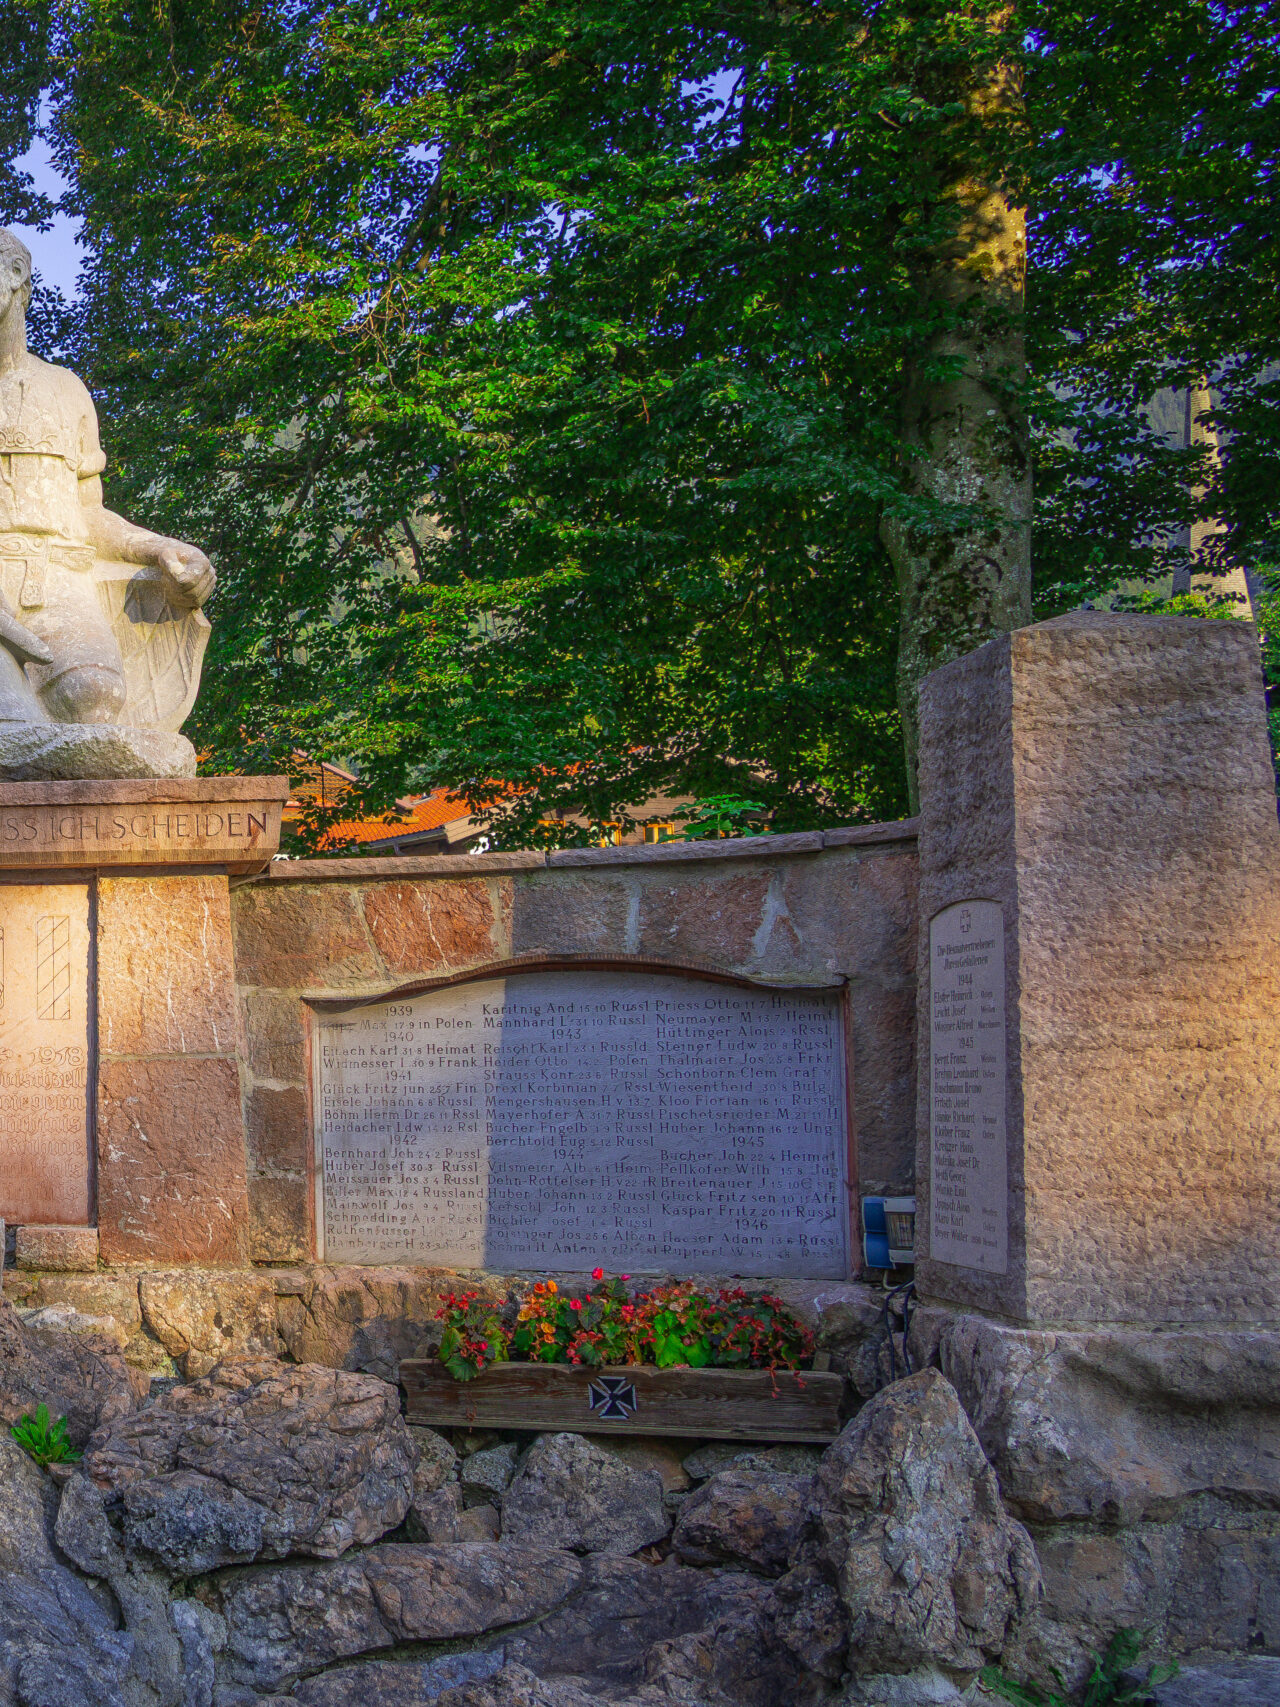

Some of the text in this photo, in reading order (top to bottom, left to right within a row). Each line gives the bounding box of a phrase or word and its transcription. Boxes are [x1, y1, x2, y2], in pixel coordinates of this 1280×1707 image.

[50, 817, 99, 840] ICH
[112, 813, 266, 838] SCHEIDEN
[656, 999, 740, 1011] Priess Otto
[385, 1006, 412, 1016] 1939
[436, 1018, 472, 1028] Polen
[484, 1016, 554, 1028] Mannhard
[656, 1014, 733, 1026] Neumayer
[385, 1032, 413, 1042] 1940
[552, 1029, 581, 1039] 1943
[370, 1044, 476, 1055] Karl Heimat
[657, 1041, 711, 1051] Steiner
[439, 1057, 477, 1067] Frank
[484, 1055, 647, 1066] Heider Otto Polen
[659, 1053, 763, 1065] Thalmaier Jos
[386, 1071, 411, 1080] 1941
[484, 1070, 535, 1080] Strauss
[741, 1067, 776, 1078] Clem
[365, 1084, 397, 1094] Fritz
[485, 1082, 596, 1093] Drexl Korbinian
[659, 1081, 752, 1092] Wiesentheid
[485, 1096, 595, 1108] Mengershausen
[486, 1109, 569, 1122] Mayerhofer
[659, 1109, 769, 1120] Pischetsrieder
[325, 1122, 392, 1133] Heidacher
[486, 1122, 534, 1133] Bucher
[660, 1123, 704, 1134] Huber
[712, 1123, 764, 1133] Johann
[390, 1135, 417, 1145] 1942
[732, 1136, 764, 1147] 1945
[325, 1148, 413, 1158] Bernhard Joh
[554, 1149, 584, 1159] 1944
[719, 1150, 835, 1161] Joh Heimat
[326, 1160, 404, 1171] Huber Josef
[327, 1173, 392, 1183] Meissauer
[398, 1174, 418, 1183] Jos
[661, 1177, 752, 1188] Breitenauer
[367, 1186, 484, 1198] Max Russland
[488, 1188, 585, 1199] Huber Johann
[662, 1204, 756, 1218] Kaspar Fritz
[736, 1219, 767, 1230] 1946
